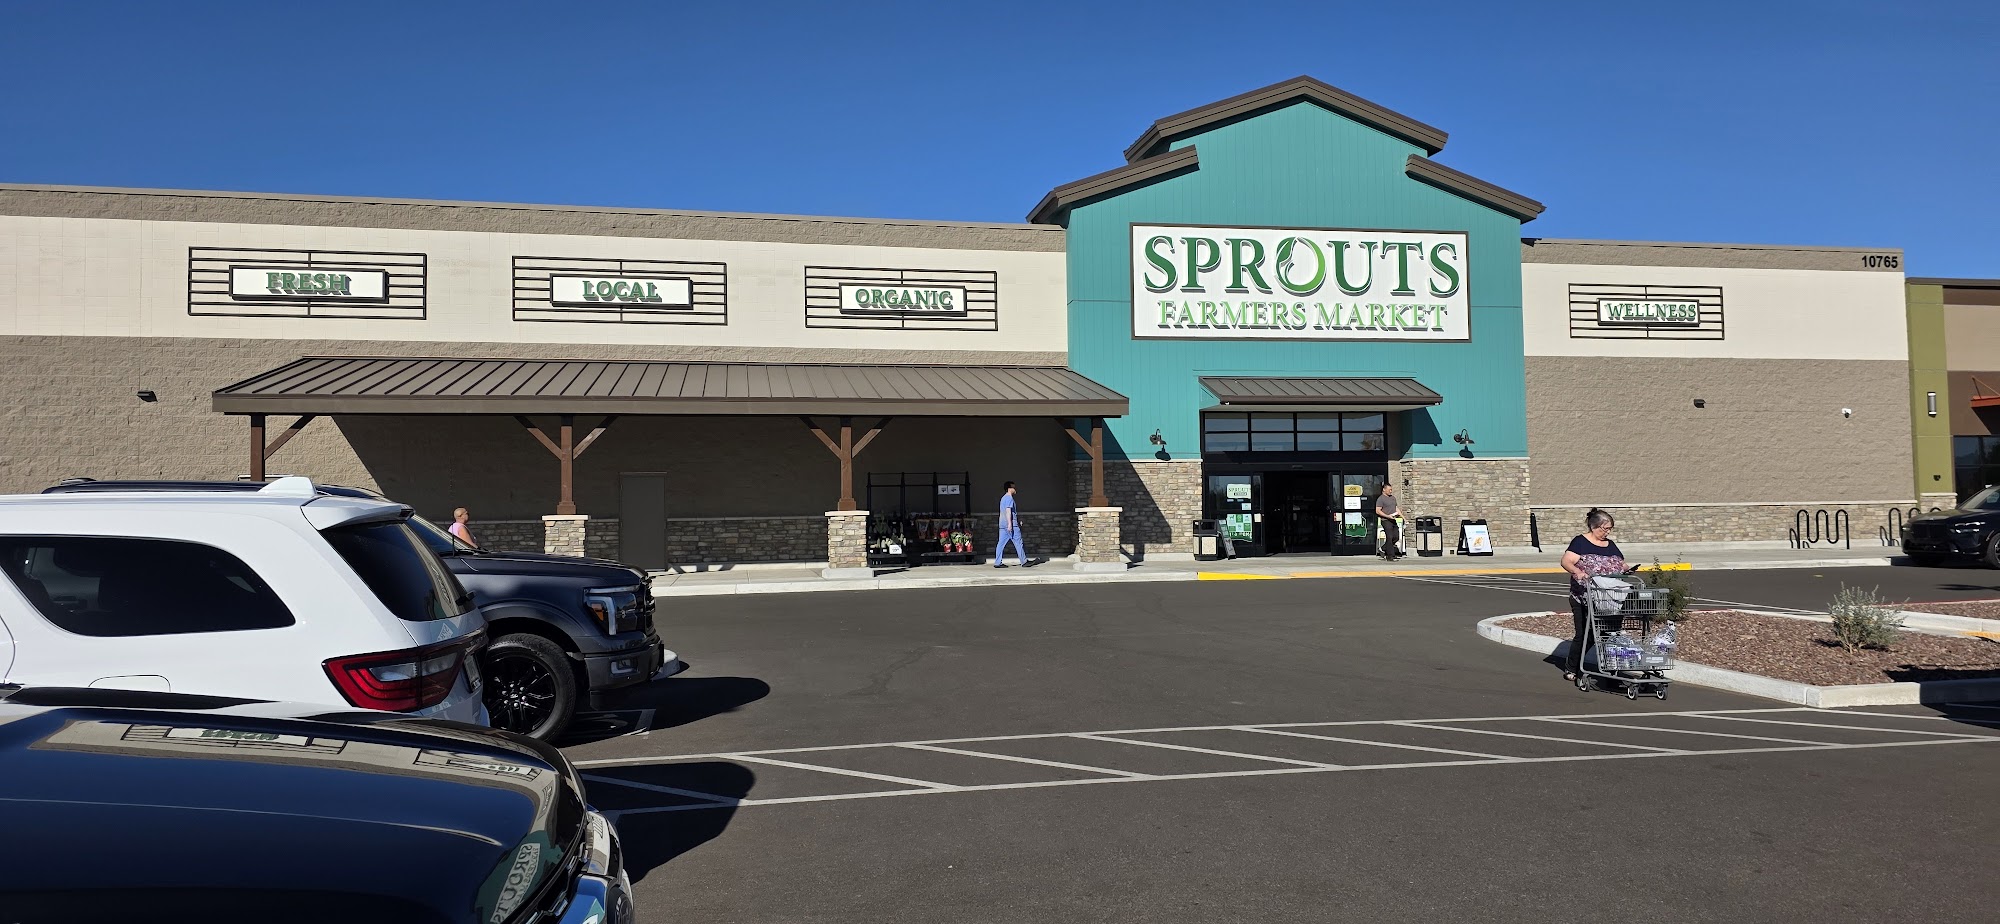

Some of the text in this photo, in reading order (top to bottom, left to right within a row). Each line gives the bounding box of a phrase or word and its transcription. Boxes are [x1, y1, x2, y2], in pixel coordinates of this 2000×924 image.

[1143, 235, 1460, 297] SPROUTS
[1861, 255, 1898, 268] 10765
[266, 272, 350, 294] FRESH
[582, 280, 660, 302] LOCAL
[856, 288, 953, 310] ORGANIC
[1158, 300, 1448, 331] FARMERS MARKET
[1605, 303, 1697, 320] WELLNESS
